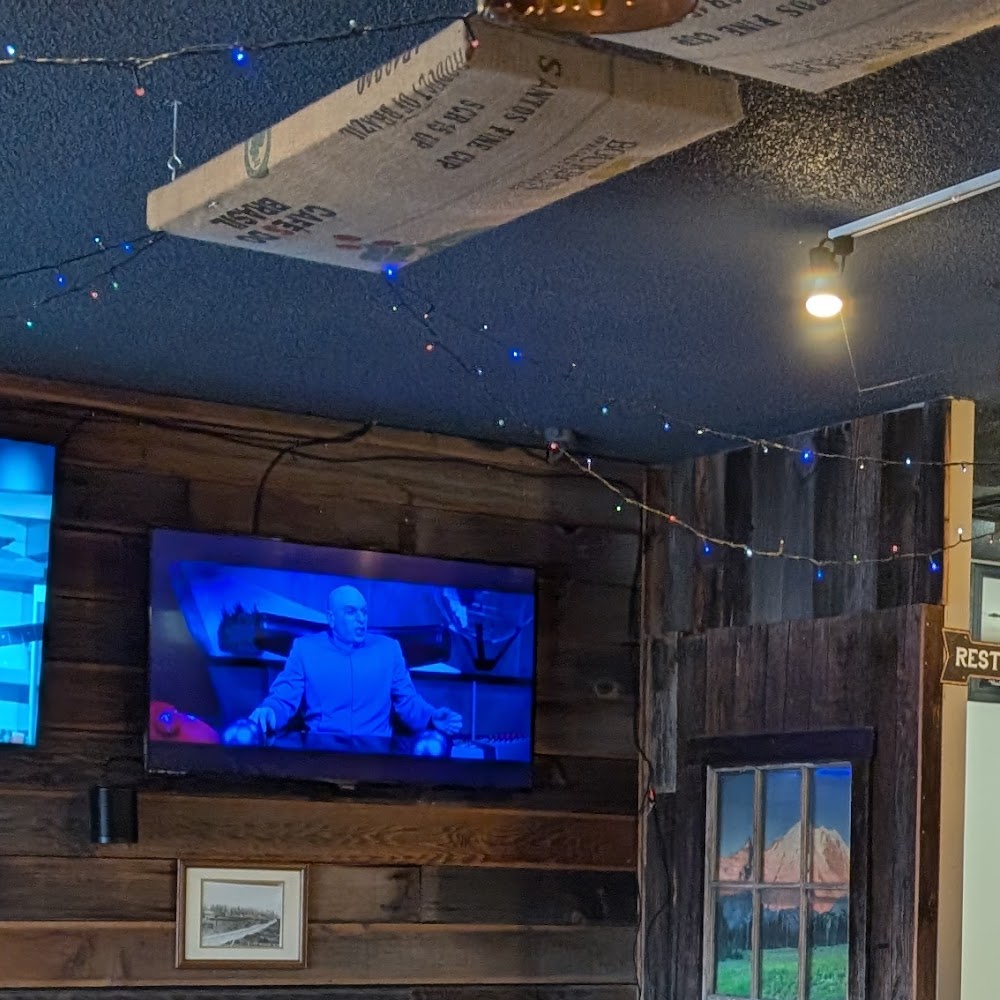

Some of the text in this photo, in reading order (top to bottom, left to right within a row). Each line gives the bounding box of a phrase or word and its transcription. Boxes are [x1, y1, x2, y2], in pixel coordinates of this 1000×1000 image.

[504, 55, 562, 123] SANTOS
[467, 125, 515, 151] FINE
[210, 197, 291, 230] BRASIL
